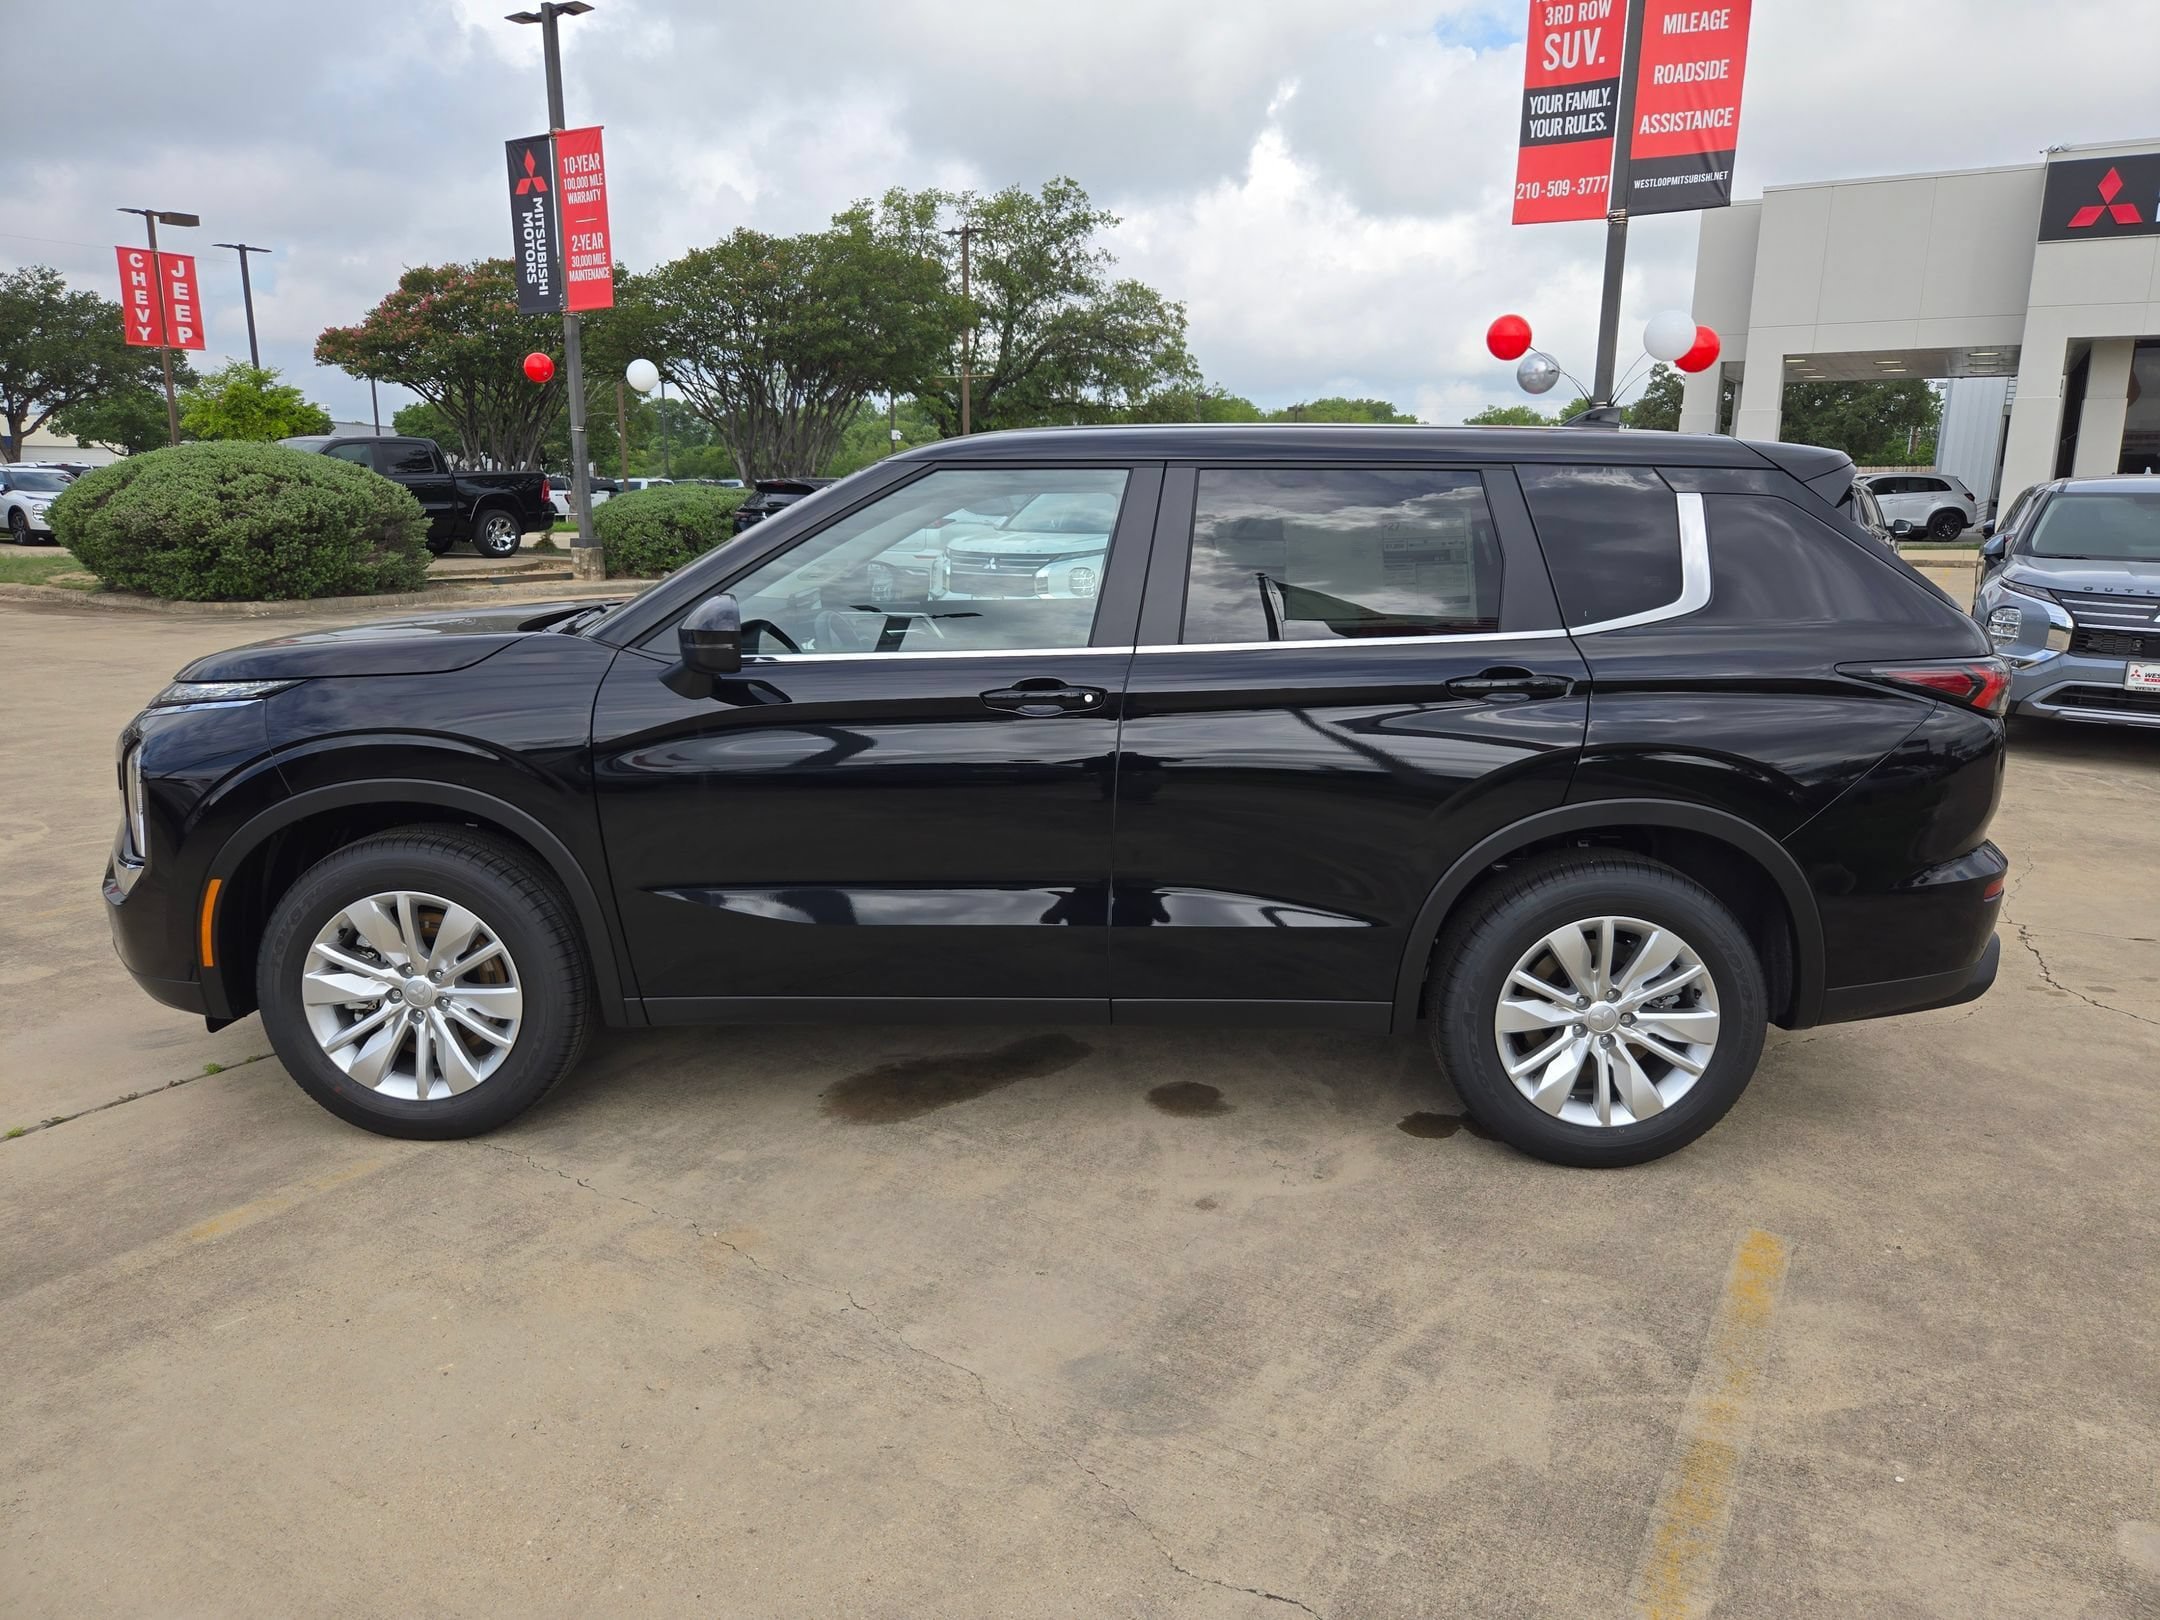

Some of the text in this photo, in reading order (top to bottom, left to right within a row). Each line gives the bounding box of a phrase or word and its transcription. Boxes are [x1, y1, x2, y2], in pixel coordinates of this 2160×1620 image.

[1544, 0, 1612, 26] 3RD ROW
[1663, 8, 1731, 35] MILEAGE
[1542, 27, 1606, 71] SUV.
[1653, 58, 1730, 85] ROADSIDE
[1529, 86, 1612, 116] YOUR FAMILY.
[1529, 112, 1607, 139] YOUR RULES.
[1639, 107, 1734, 135] ASSISTANCE
[563, 152, 601, 175] 10-YEAR
[563, 173, 604, 191] 100,000 MILE
[1634, 170, 1729, 189] WESTLOOPMITSUBISHI.NET
[567, 188, 601, 205] WARRANTY
[522, 212, 537, 284] MOTORS
[533, 197, 549, 296] MITSUBISHI
[571, 232, 605, 252] 2-YEAR
[571, 252, 607, 268] 30,000 MILE
[568, 266, 611, 282] MAINTENANCE
[129, 253, 152, 341] CHEVY
[171, 260, 193, 344] JEEP
